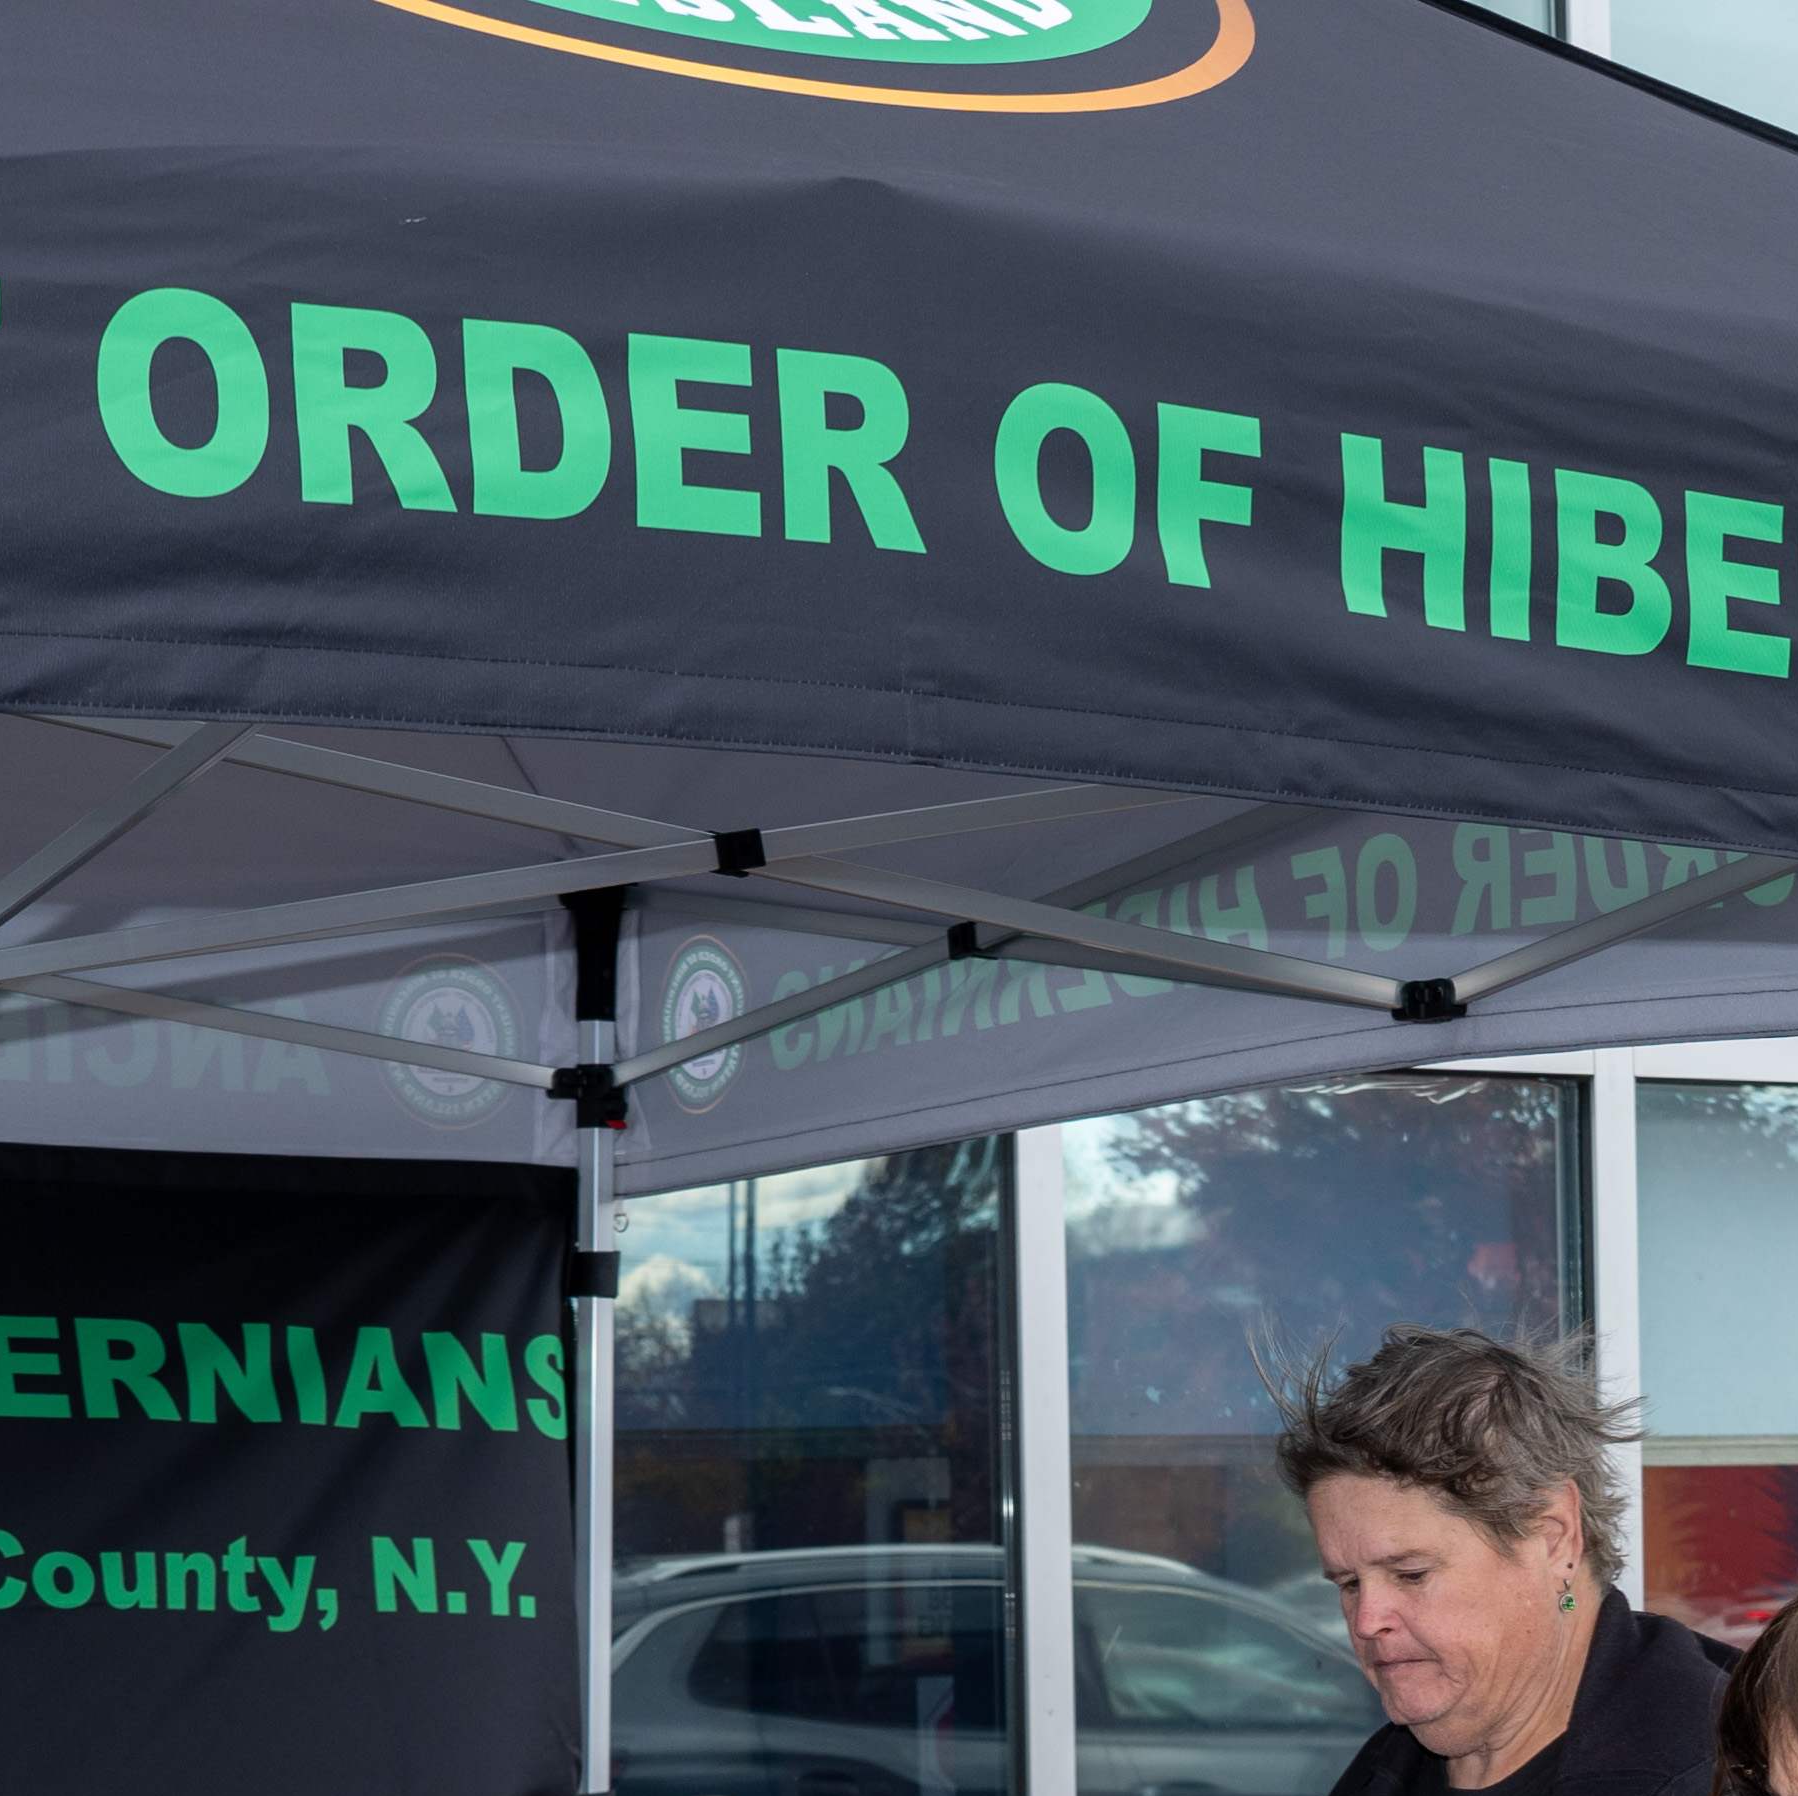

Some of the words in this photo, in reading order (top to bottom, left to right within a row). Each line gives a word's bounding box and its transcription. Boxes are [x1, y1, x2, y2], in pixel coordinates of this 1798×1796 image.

[96, 287, 927, 554] ORDER
[994, 382, 1262, 588] OF
[371, 1536, 537, 1619] N.Y.
